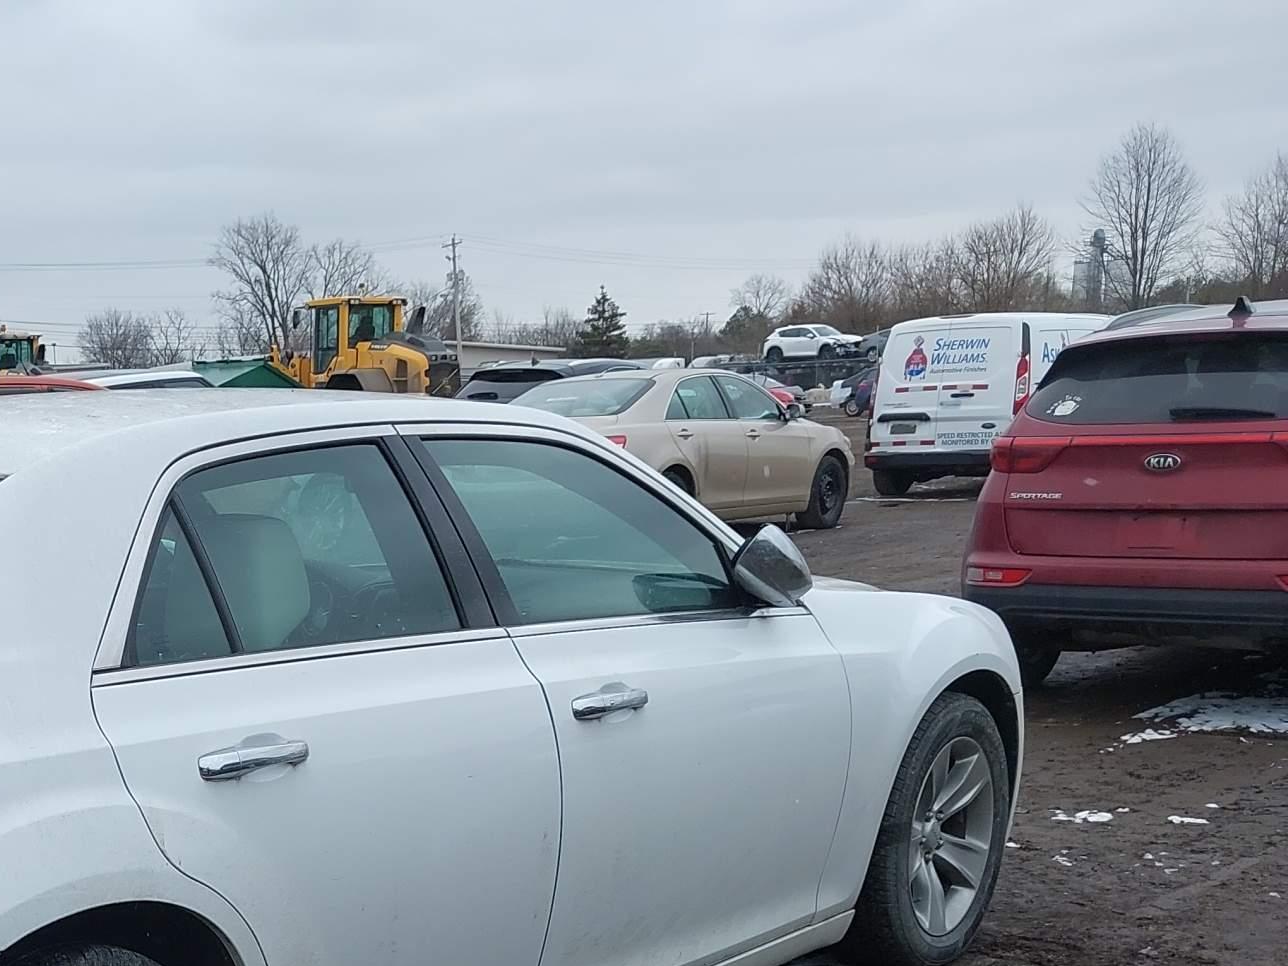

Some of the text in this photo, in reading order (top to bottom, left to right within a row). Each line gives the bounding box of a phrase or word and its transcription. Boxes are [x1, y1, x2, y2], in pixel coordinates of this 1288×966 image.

[933, 337, 991, 352] SHERWIN
[930, 352, 987, 365] WILLIAMS
[941, 439, 979, 447] MONITORED
[1149, 457, 1175, 469] KIA
